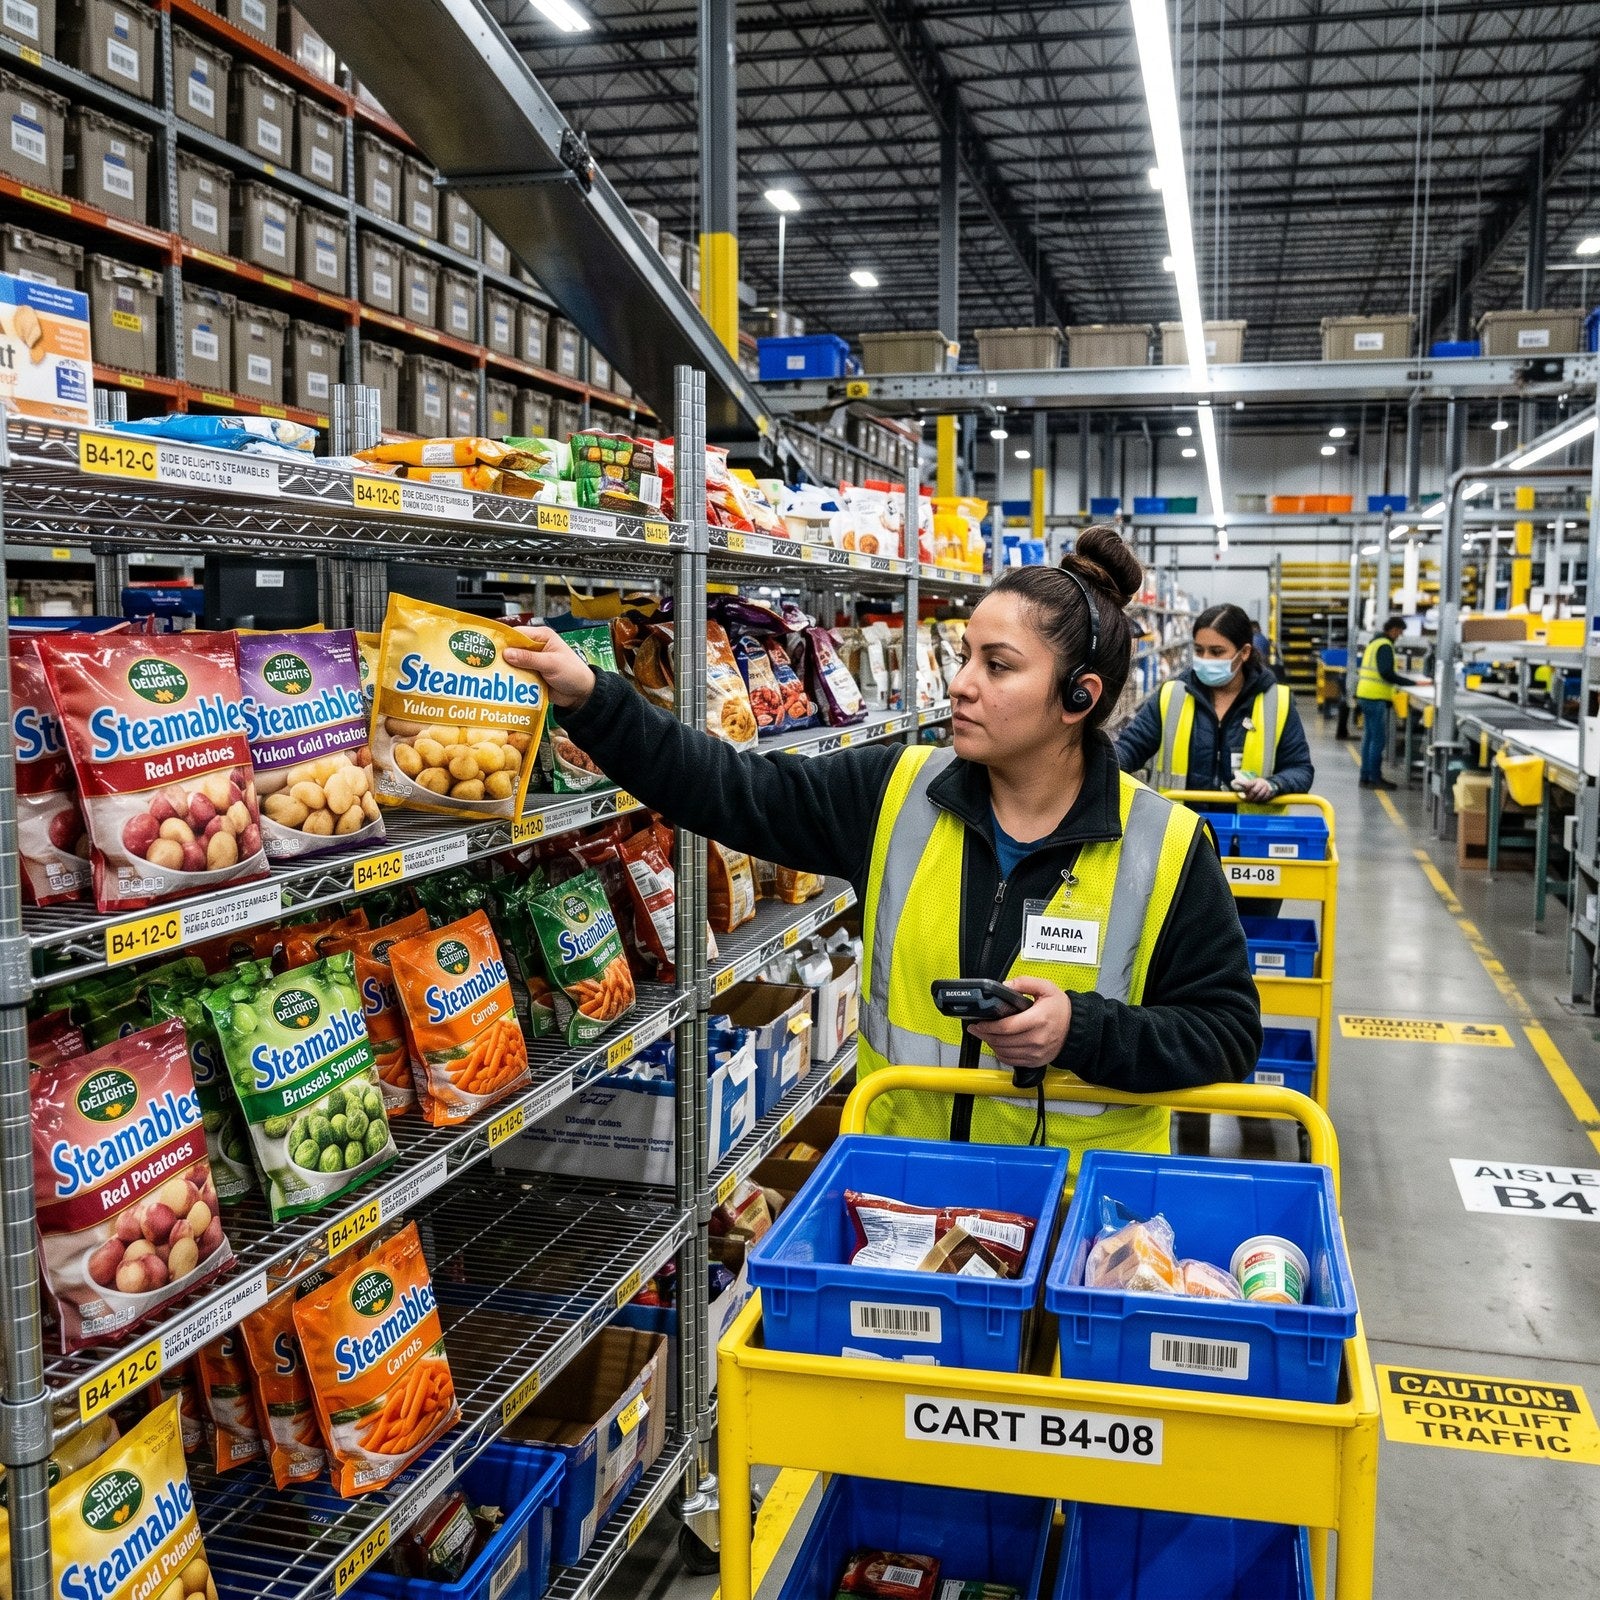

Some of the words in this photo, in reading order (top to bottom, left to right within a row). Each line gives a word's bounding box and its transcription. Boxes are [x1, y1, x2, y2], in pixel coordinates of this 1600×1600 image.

[86, 443, 154, 471] B4-12-C
[160, 453, 180, 465] SIDE
[182, 455, 220, 471] DELIGHTS
[223, 462, 270, 478] STEAMABLES
[358, 485, 399, 505] B4-12-C
[540, 511, 568, 528] B4-12-C
[140, 664, 167, 676] SIDE
[266, 668, 310, 682] DELIGHTS
[276, 658, 296, 669] SIDE
[131, 675, 186, 690] DELIGHTS
[396, 653, 539, 704] Steamables
[403, 699, 444, 718] Yukon
[448, 705, 476, 720] Gold
[480, 708, 531, 726] Potatoes
[144, 762, 174, 780] Red
[177, 746, 235, 772] Potatoes
[252, 742, 295, 764] Yukon
[298, 734, 323, 755] Gold
[358, 858, 401, 884] B4-12-C
[1231, 868, 1275, 881] B4-08
[184, 912, 200, 924] SIDE
[113, 920, 177, 954] B4-12-C
[1041, 926, 1083, 940] MARIA
[1036, 942, 1087, 954] FULFILLMENT
[280, 991, 304, 1007] SIDE
[426, 958, 508, 1024] Steamable
[88, 1073, 118, 1093] SIDE
[282, 1071, 331, 1107] Brussels
[331, 1047, 369, 1080] Sprouts
[80, 1082, 136, 1112] DELIGHTS
[53, 1087, 202, 1195] Steamables
[101, 1179, 131, 1210] Red
[131, 1141, 193, 1190] Potatoes
[1475, 1167, 1600, 1187] AISLE
[1494, 1185, 1597, 1214] B4
[357, 1275, 379, 1294] SIDE
[183, 1308, 218, 1337] DELIGHTS
[219, 1280, 262, 1314] STEAMABLES
[387, 1338, 423, 1376] Carrots
[86, 1350, 157, 1411] B4-12-C
[1399, 1376, 1568, 1409] CAUTION:
[914, 1403, 1026, 1442] CART
[1040, 1415, 1154, 1456] B4-08
[1403, 1400, 1572, 1432] FORKLIFT
[1416, 1421, 1572, 1453] TRAFFIC
[86, 1478, 140, 1526] DELIGHTS
[91, 1475, 121, 1502] SIDE
[61, 1472, 193, 1600] Steamable
[339, 1530, 386, 1586] B4-19-C
[132, 1564, 162, 1600] Gold
